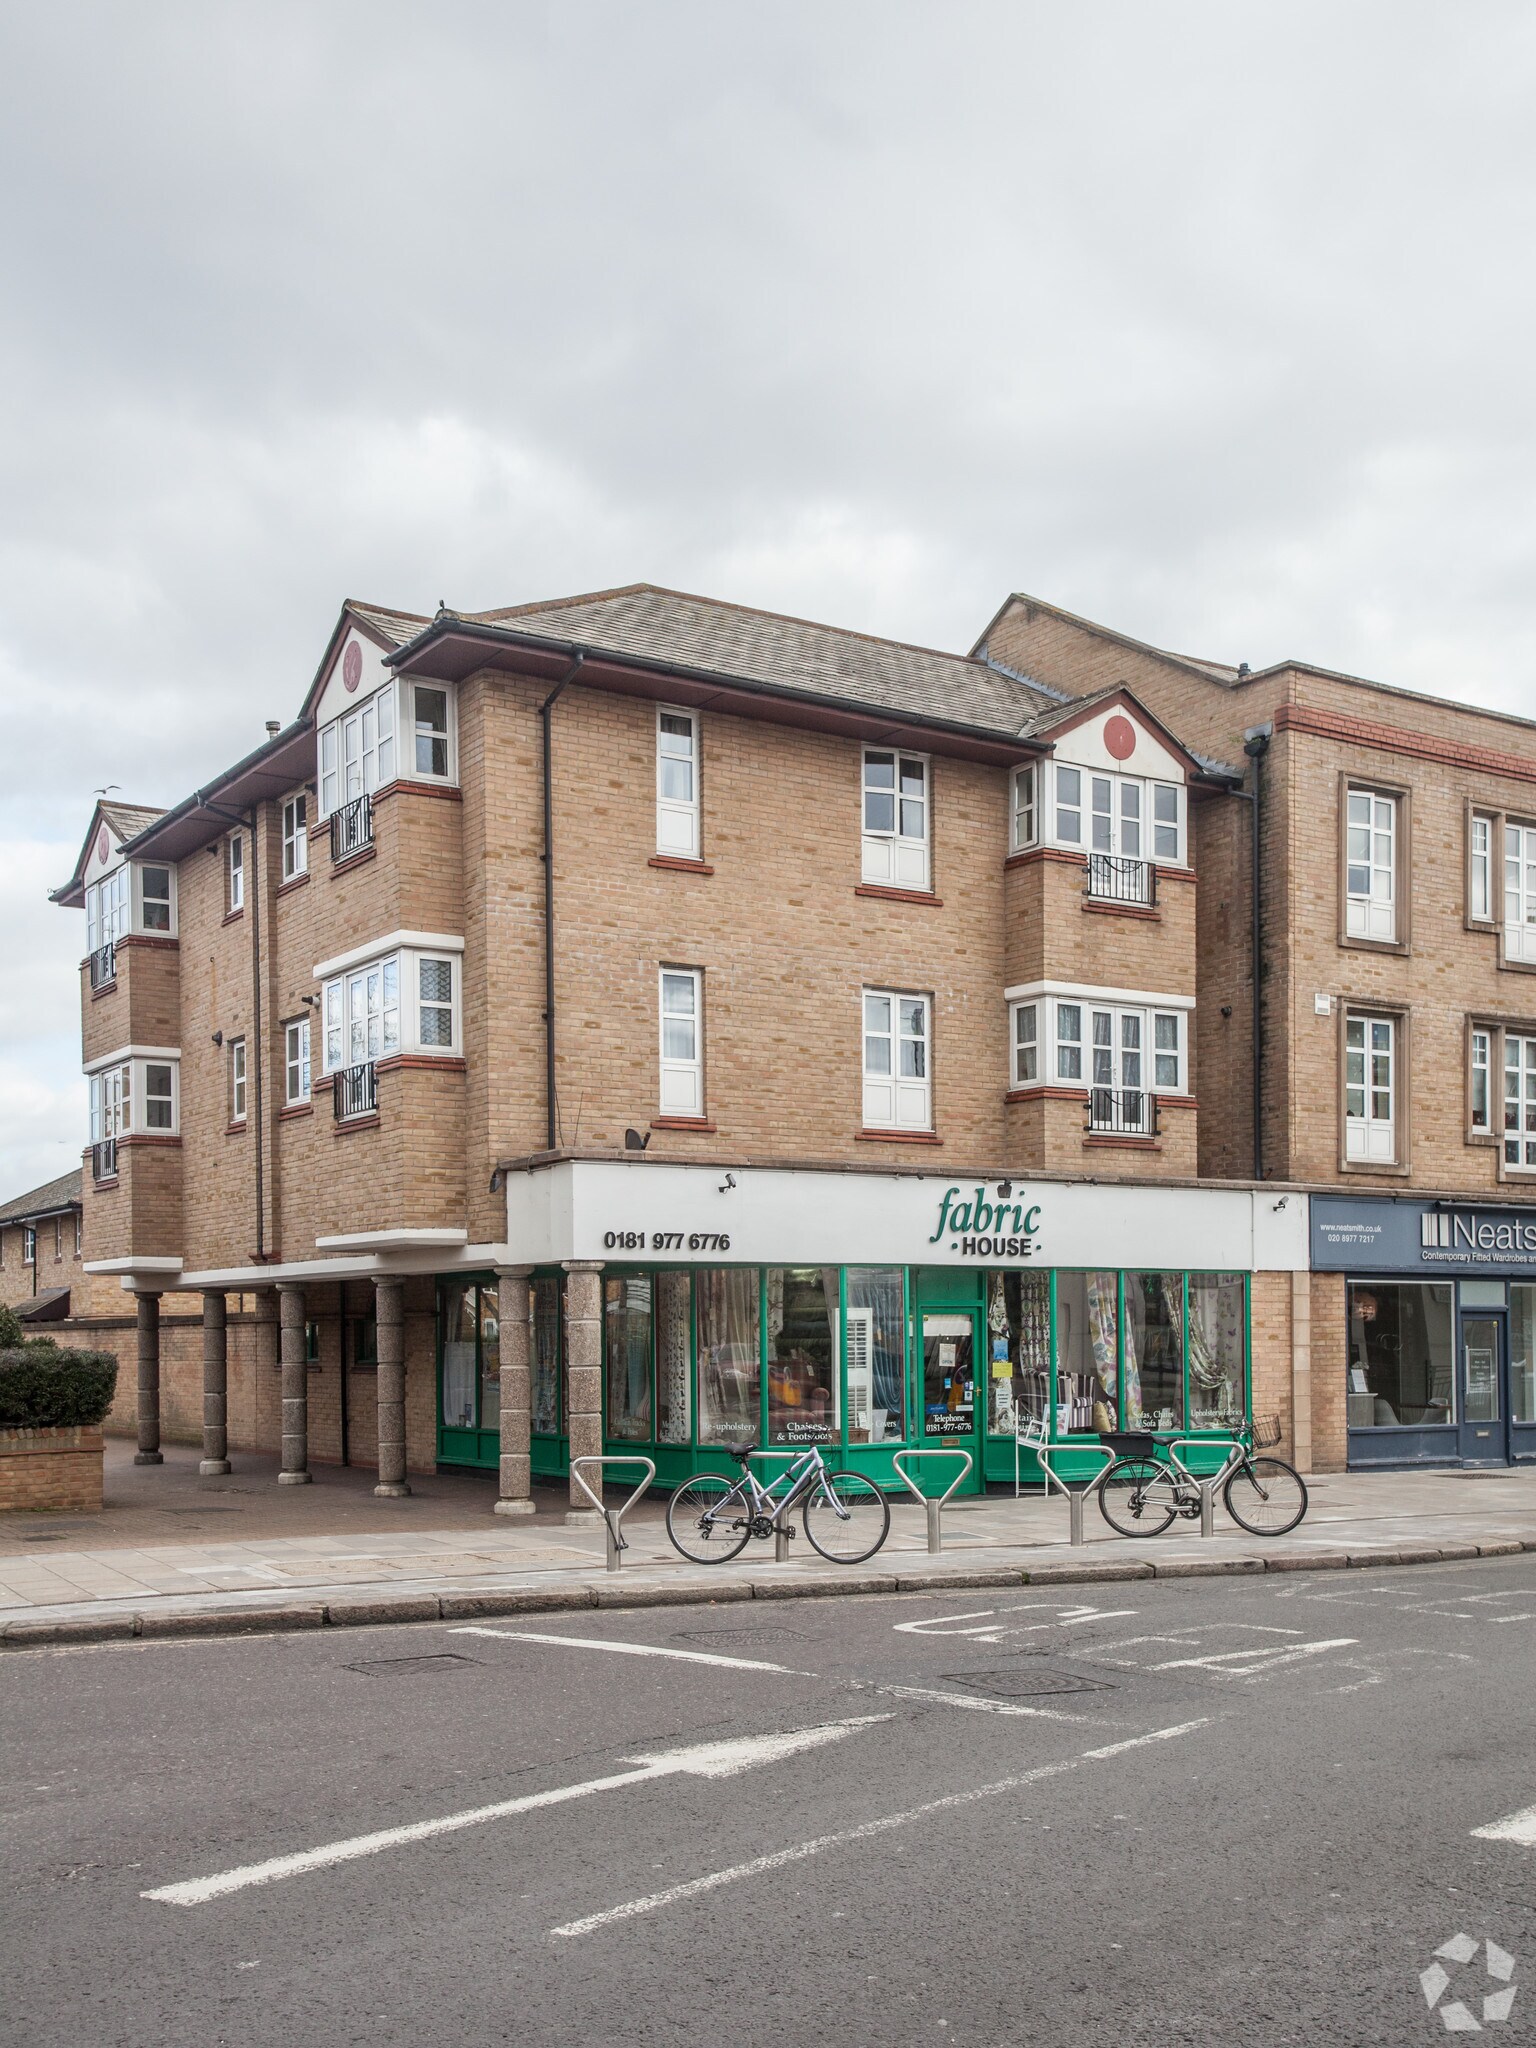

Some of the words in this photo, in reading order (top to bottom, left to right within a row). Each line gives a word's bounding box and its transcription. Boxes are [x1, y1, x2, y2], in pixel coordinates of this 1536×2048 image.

[929, 1187, 1041, 1243] fabric
[1320, 1224, 1382, 1233] www.neatsmith.co.uk
[603, 1231, 645, 1249] 0181
[652, 1232, 685, 1250] 977
[688, 1233, 730, 1250] 6776
[1327, 1234, 1340, 1242] 020
[1341, 1234, 1357, 1242] 8977
[1359, 1235, 1375, 1243] 7217
[962, 1236, 1032, 1256] HOUSE
[1422, 1250, 1471, 1263] Contemporary
[1472, 1252, 1491, 1262] Fitted
[1492, 1252, 1527, 1263] Wardrobes
[933, 1413, 965, 1424] Telephone
[1142, 1419, 1157, 1428] Sofa
[703, 1421, 757, 1434] Re-upholstery
[926, 1422, 972, 1432] 0181-977-6776
[776, 1432, 786, 1441] &
